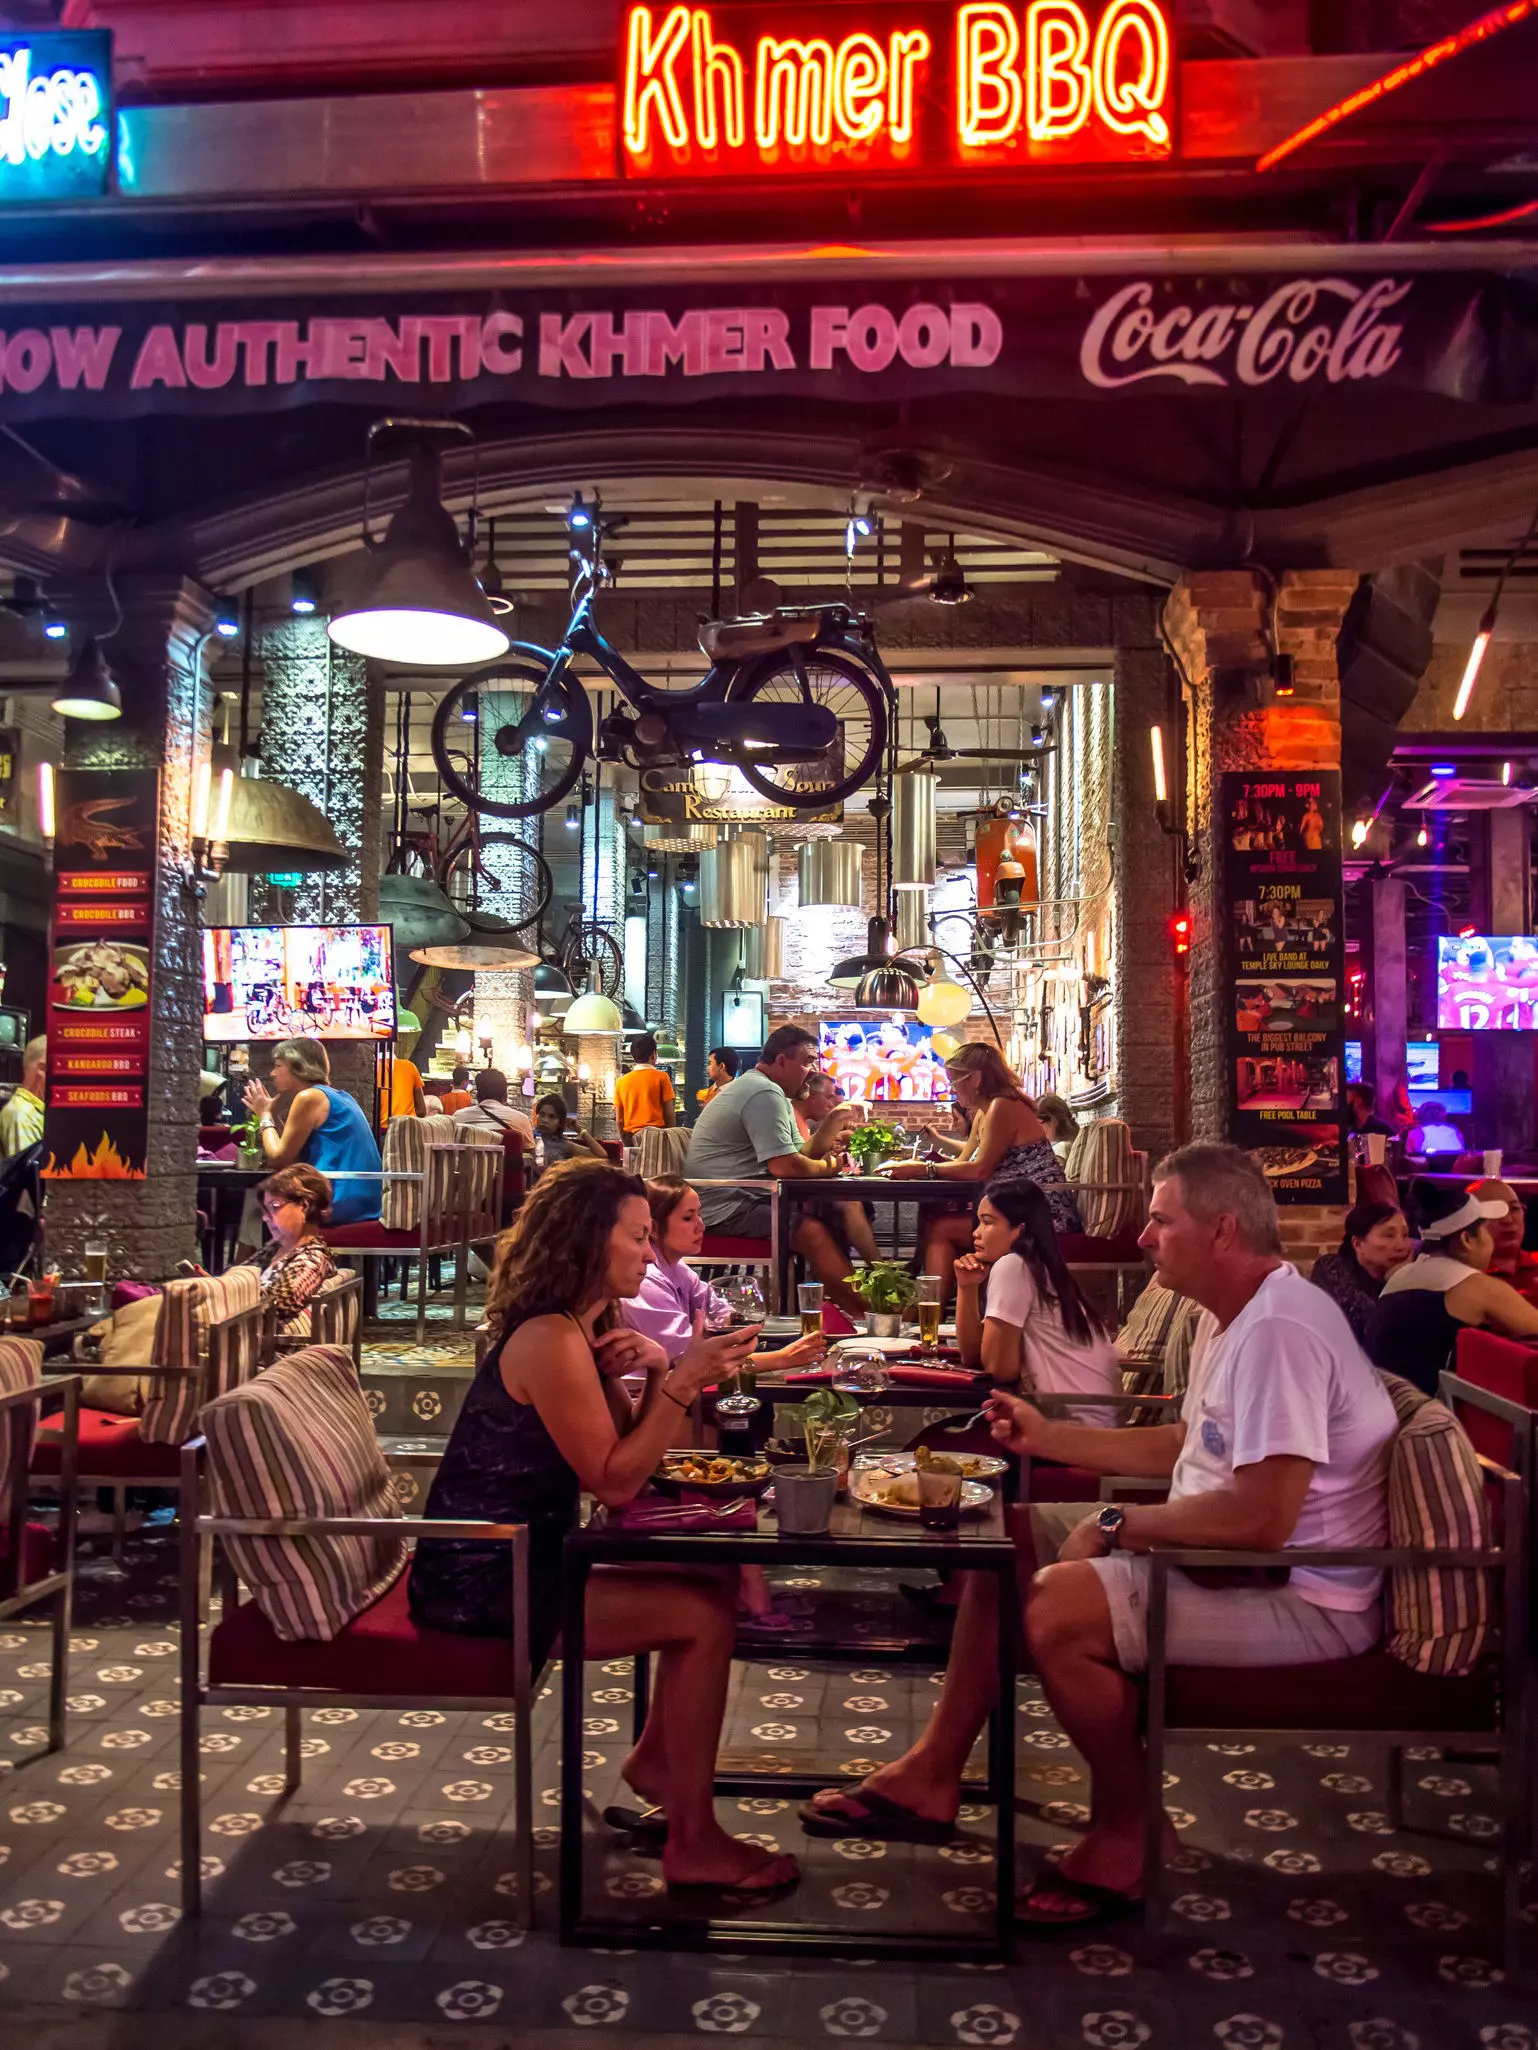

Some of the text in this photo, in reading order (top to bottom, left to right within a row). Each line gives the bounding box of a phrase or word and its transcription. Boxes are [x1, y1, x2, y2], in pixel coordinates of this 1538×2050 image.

[622, 0, 1171, 153] Khmer BBQ
[1079, 278, 1415, 388] Coca-Cola
[0, 303, 1003, 395] OW AUTHENTIC KHMER FOOD
[1243, 784, 1285, 799] 7:30PM
[1296, 783, 1321, 798] 9PM
[684, 795, 798, 822] Restaurant
[71, 877, 139, 888] CROCODILE FOOD
[1259, 885, 1301, 900] 7:30PM
[73, 909, 117, 920] CROCODILE
[1263, 952, 1308, 961] LIVE BAND AT
[1241, 961, 1330, 970] TEMPLE SKY LOUNGE DAILY
[63, 1027, 136, 1038] CROCODILE STEAK
[1247, 1033, 1328, 1042] THE BIGGEST BALCONY
[1261, 1042, 1269, 1052] IN
[1286, 1042, 1313, 1052] STREET
[67, 1059, 113, 1070] KANGAROO
[1260, 1110, 1317, 1120] FREE POOL TABLE
[1280, 1179, 1299, 1188] OVEN
[1300, 1179, 1322, 1188] PIZZA
